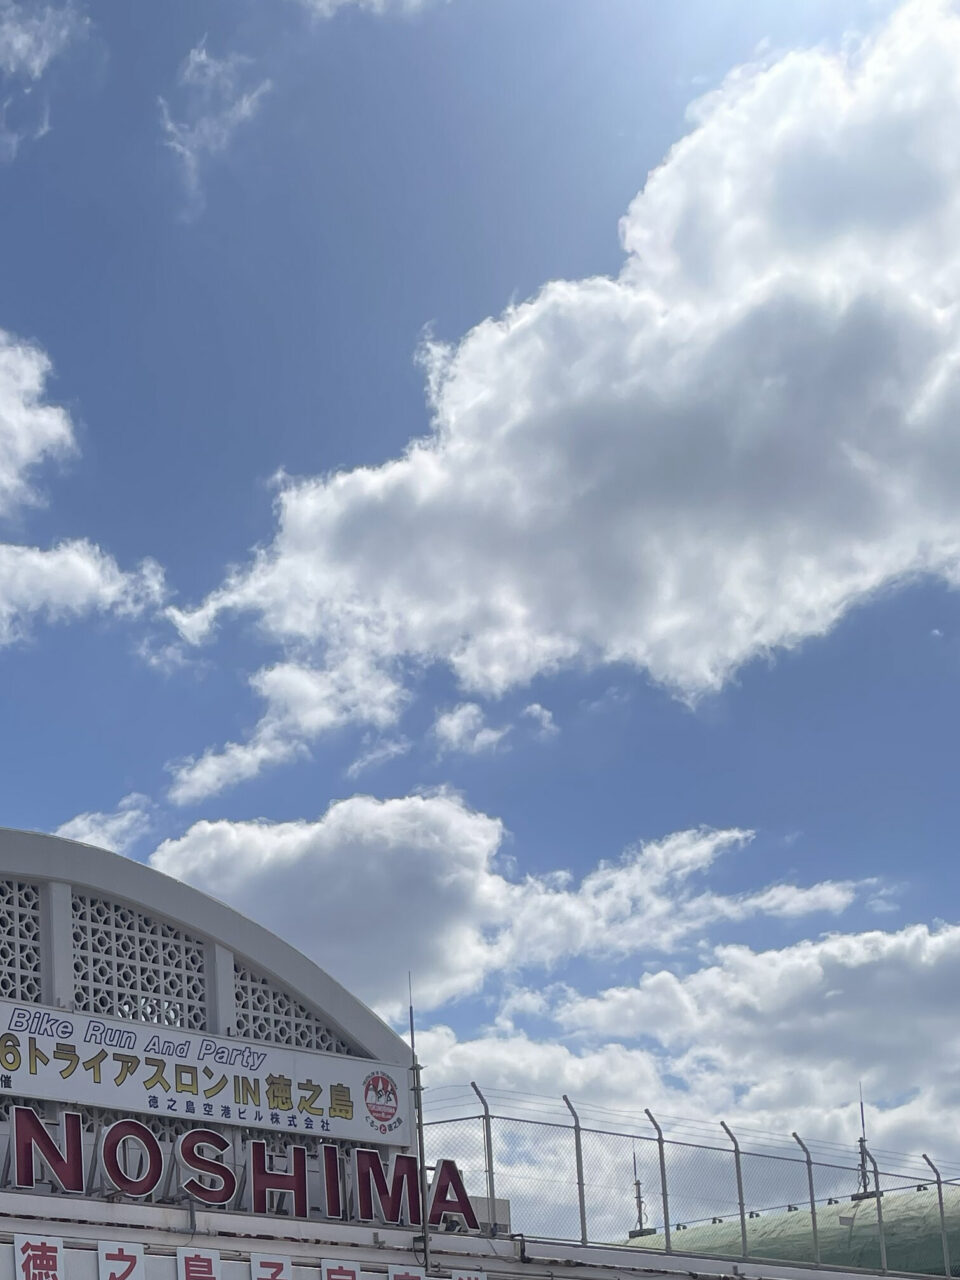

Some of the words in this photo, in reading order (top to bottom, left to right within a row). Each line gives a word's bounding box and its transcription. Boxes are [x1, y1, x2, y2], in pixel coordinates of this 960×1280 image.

[8, 1007, 74, 1039] Bike
[84, 1019, 138, 1050] Run
[143, 1035, 191, 1059] And
[196, 1038, 267, 1071] Party
[148, 1094, 332, 1132] 徳之島空港ビル株式会社
